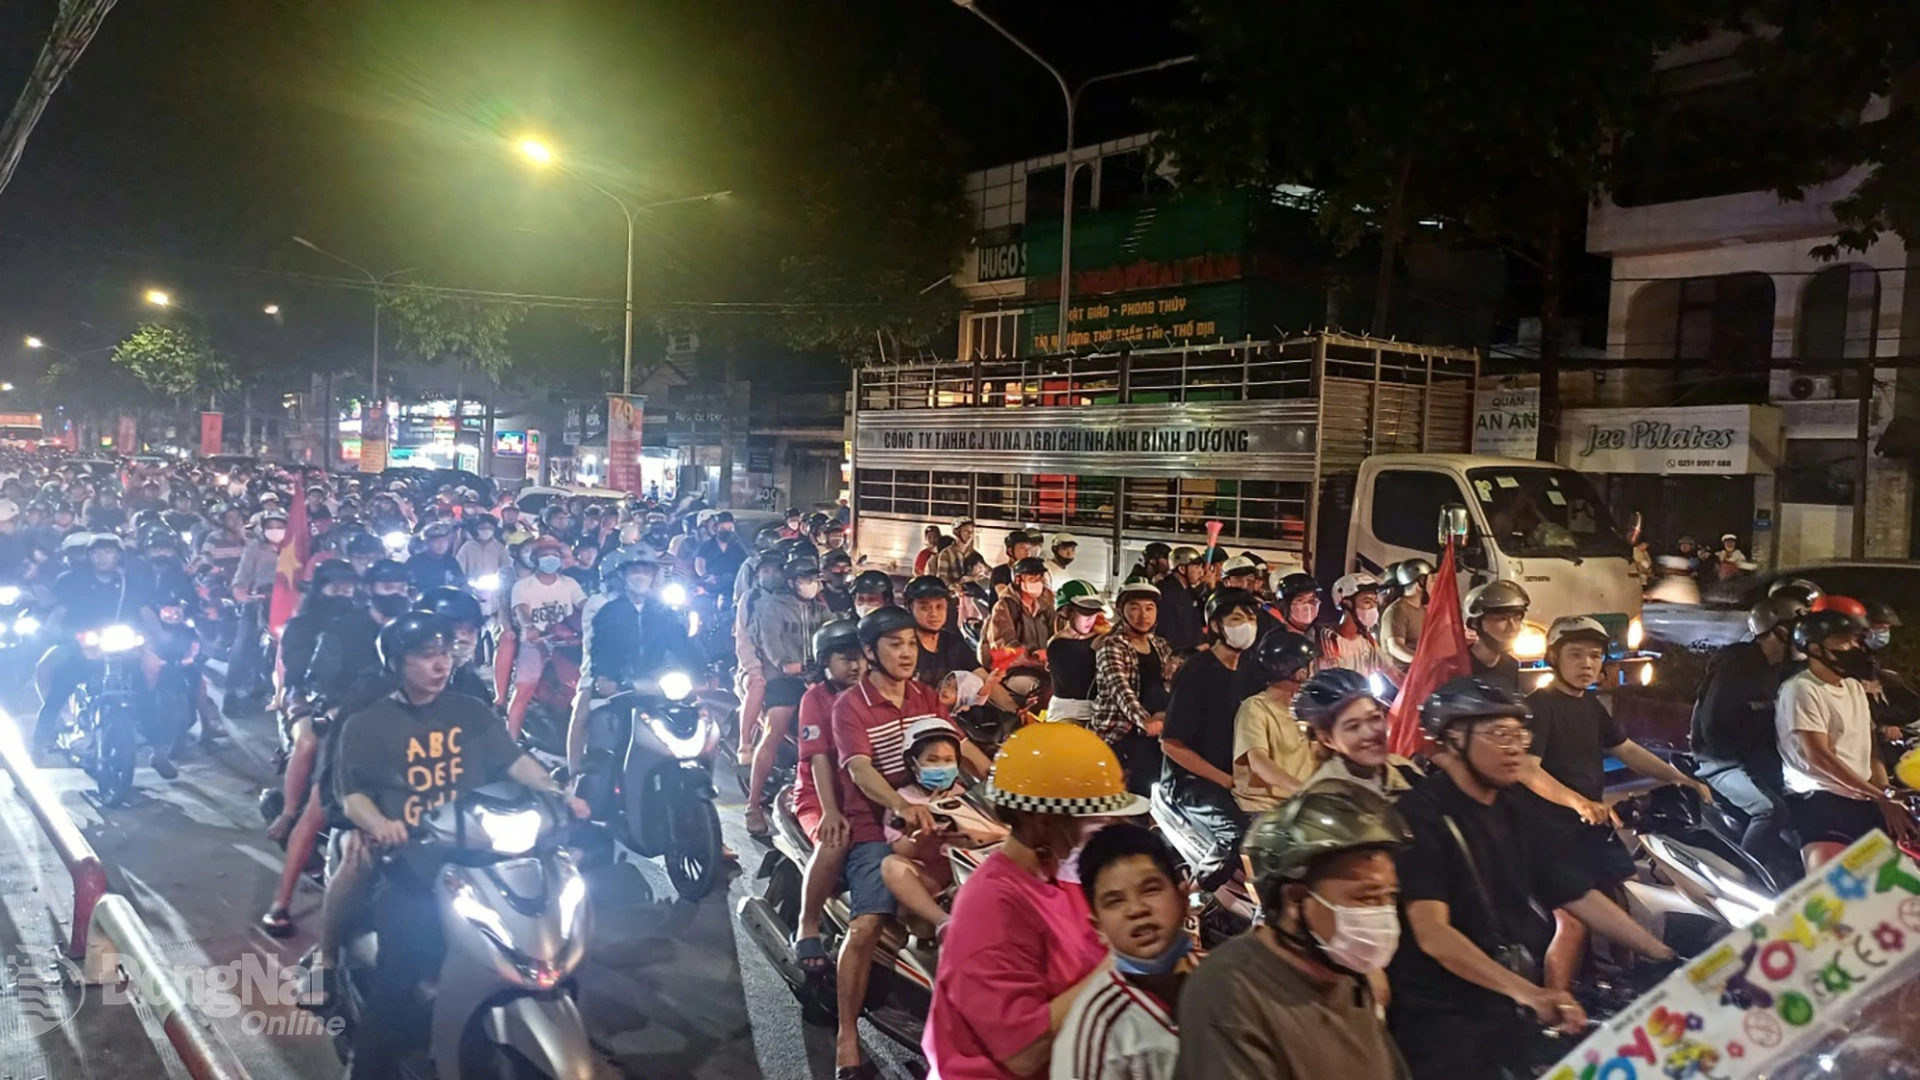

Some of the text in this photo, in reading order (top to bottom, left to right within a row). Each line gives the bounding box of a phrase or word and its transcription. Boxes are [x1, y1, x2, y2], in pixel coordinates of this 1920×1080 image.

[1121, 301, 1154, 316] PHONG
[1476, 412, 1536, 430] AN AN
[918, 431, 932, 449] TY
[935, 431, 966, 449] TNHH
[1059, 430, 1081, 451] CHI
[1141, 427, 1181, 451] BÌNH
[1579, 420, 1735, 457] Jee Pilates
